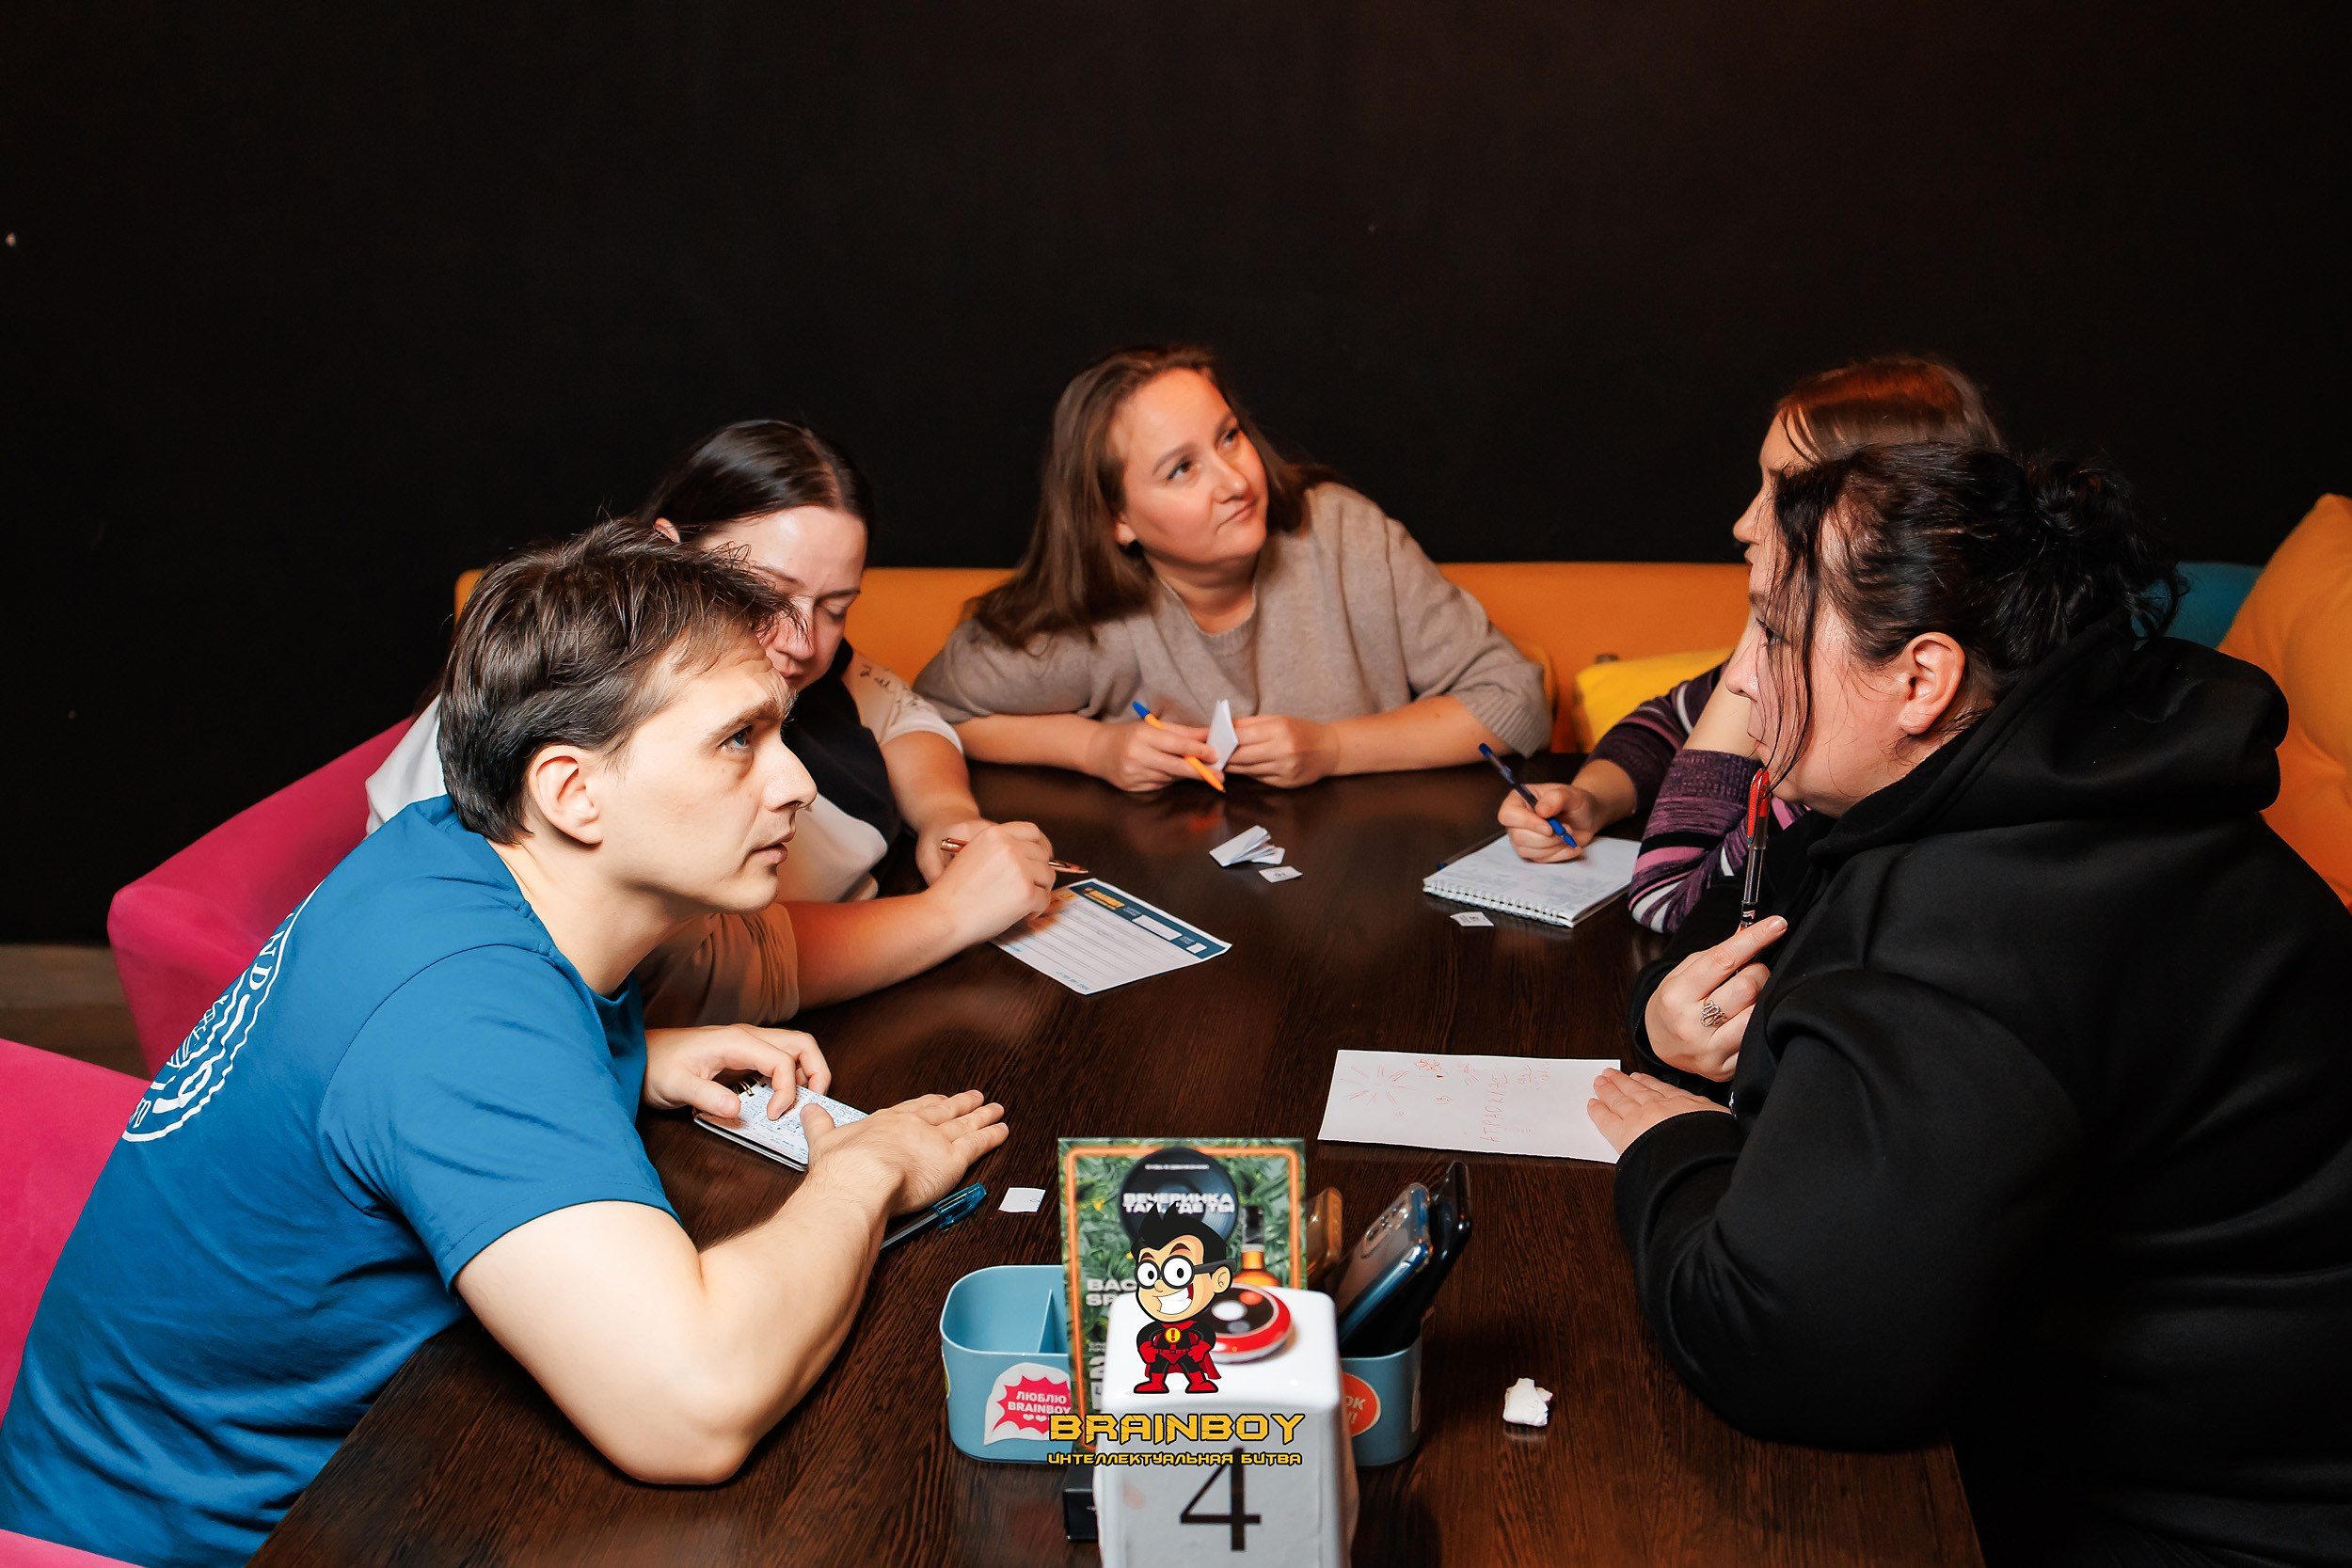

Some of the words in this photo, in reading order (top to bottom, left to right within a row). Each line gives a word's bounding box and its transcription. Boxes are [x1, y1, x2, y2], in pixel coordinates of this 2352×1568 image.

[1122, 1193, 1234, 1206] ВЕЧЕРИНКА
[1208, 1204, 1234, 1213] ТЫ
[1016, 1391, 1067, 1404] ЛЮБЛЮ
[1008, 1402, 1071, 1415] BRAINBOY
[1180, 1447, 1262, 1552] 4
